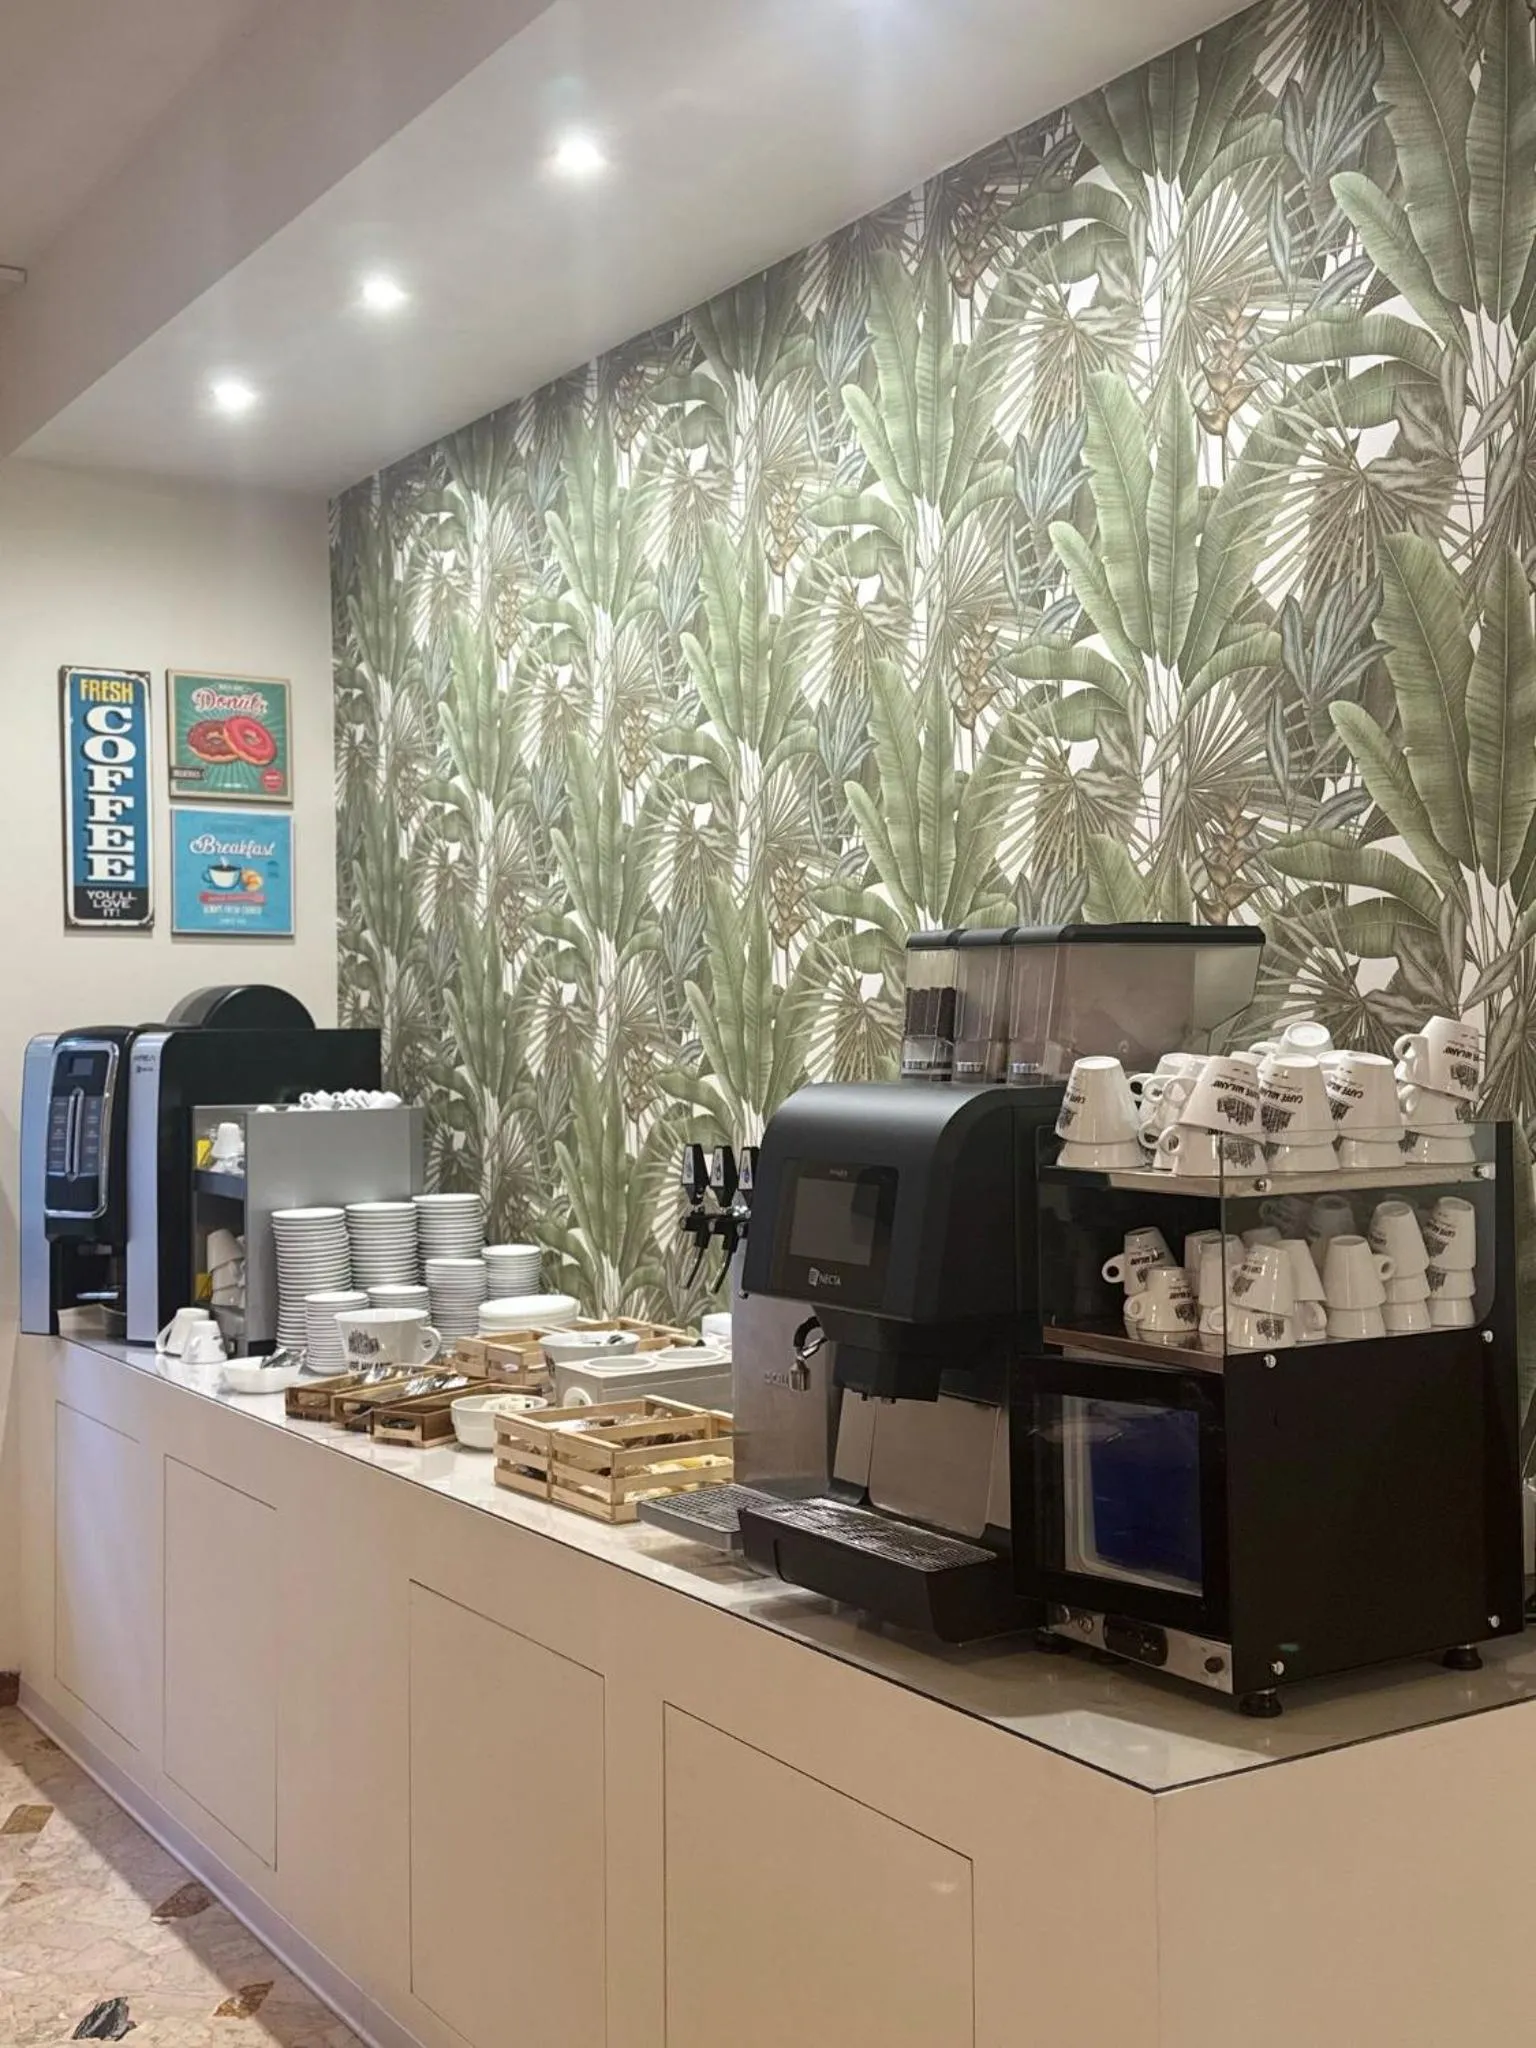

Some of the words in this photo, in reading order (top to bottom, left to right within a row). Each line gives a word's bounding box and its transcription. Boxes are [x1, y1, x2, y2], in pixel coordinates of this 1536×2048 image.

[80, 678, 134, 704] FRESH
[83, 705, 137, 882] COFFEE
[189, 833, 276, 859] Breakfast
[86, 890, 138, 900] YOU'LL
[92, 899, 131, 909] LOVE
[102, 908, 121, 917] IT!
[819, 1274, 841, 1286] NECTA
